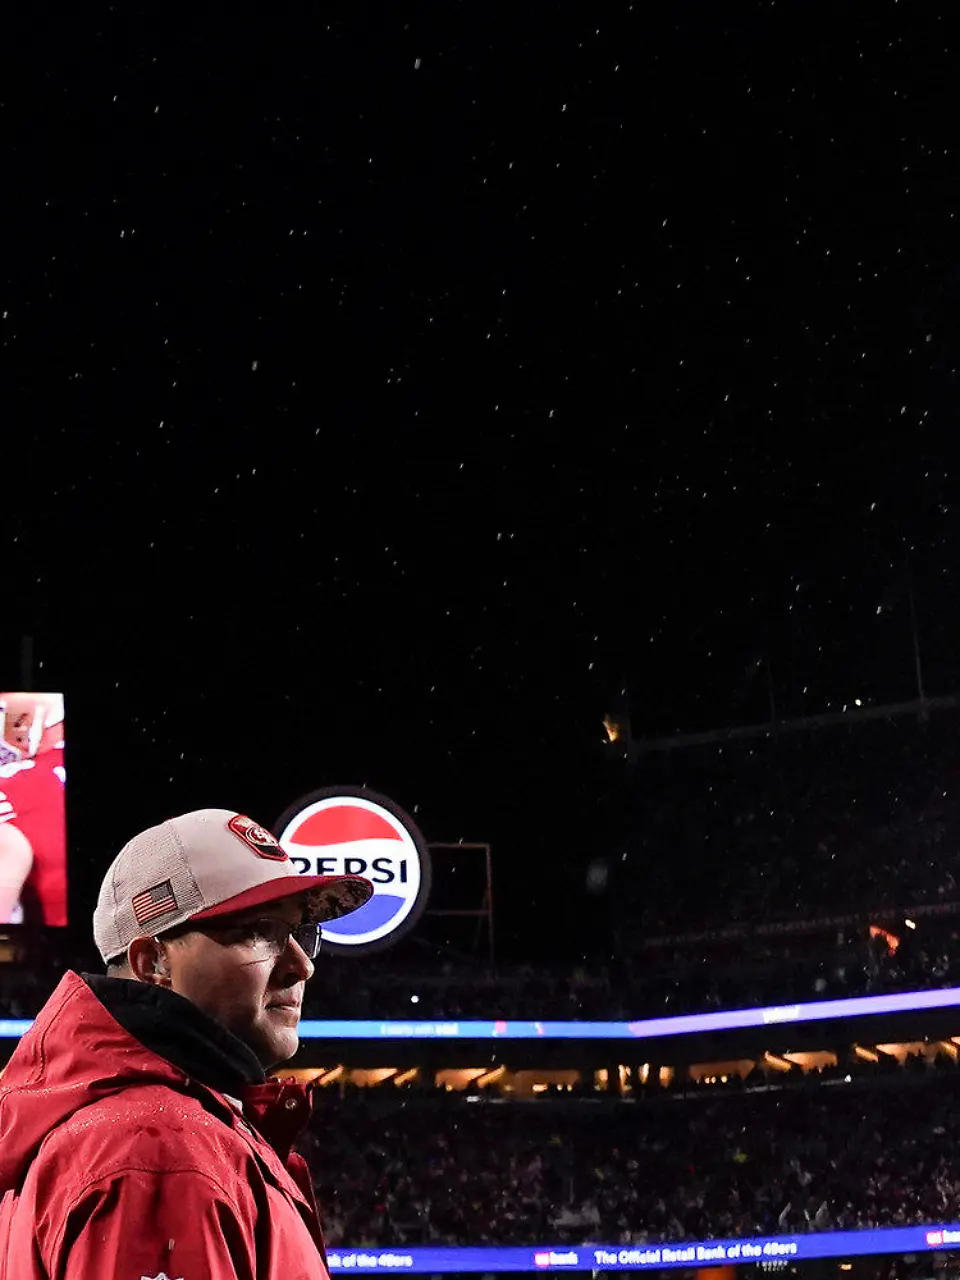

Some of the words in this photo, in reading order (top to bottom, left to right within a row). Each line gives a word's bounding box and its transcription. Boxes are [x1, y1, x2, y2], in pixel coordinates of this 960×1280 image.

[594, 1250, 618, 1265] The
[618, 1250, 661, 1265] Official
[727, 1244, 741, 1258] of
[742, 1243, 762, 1257] the
